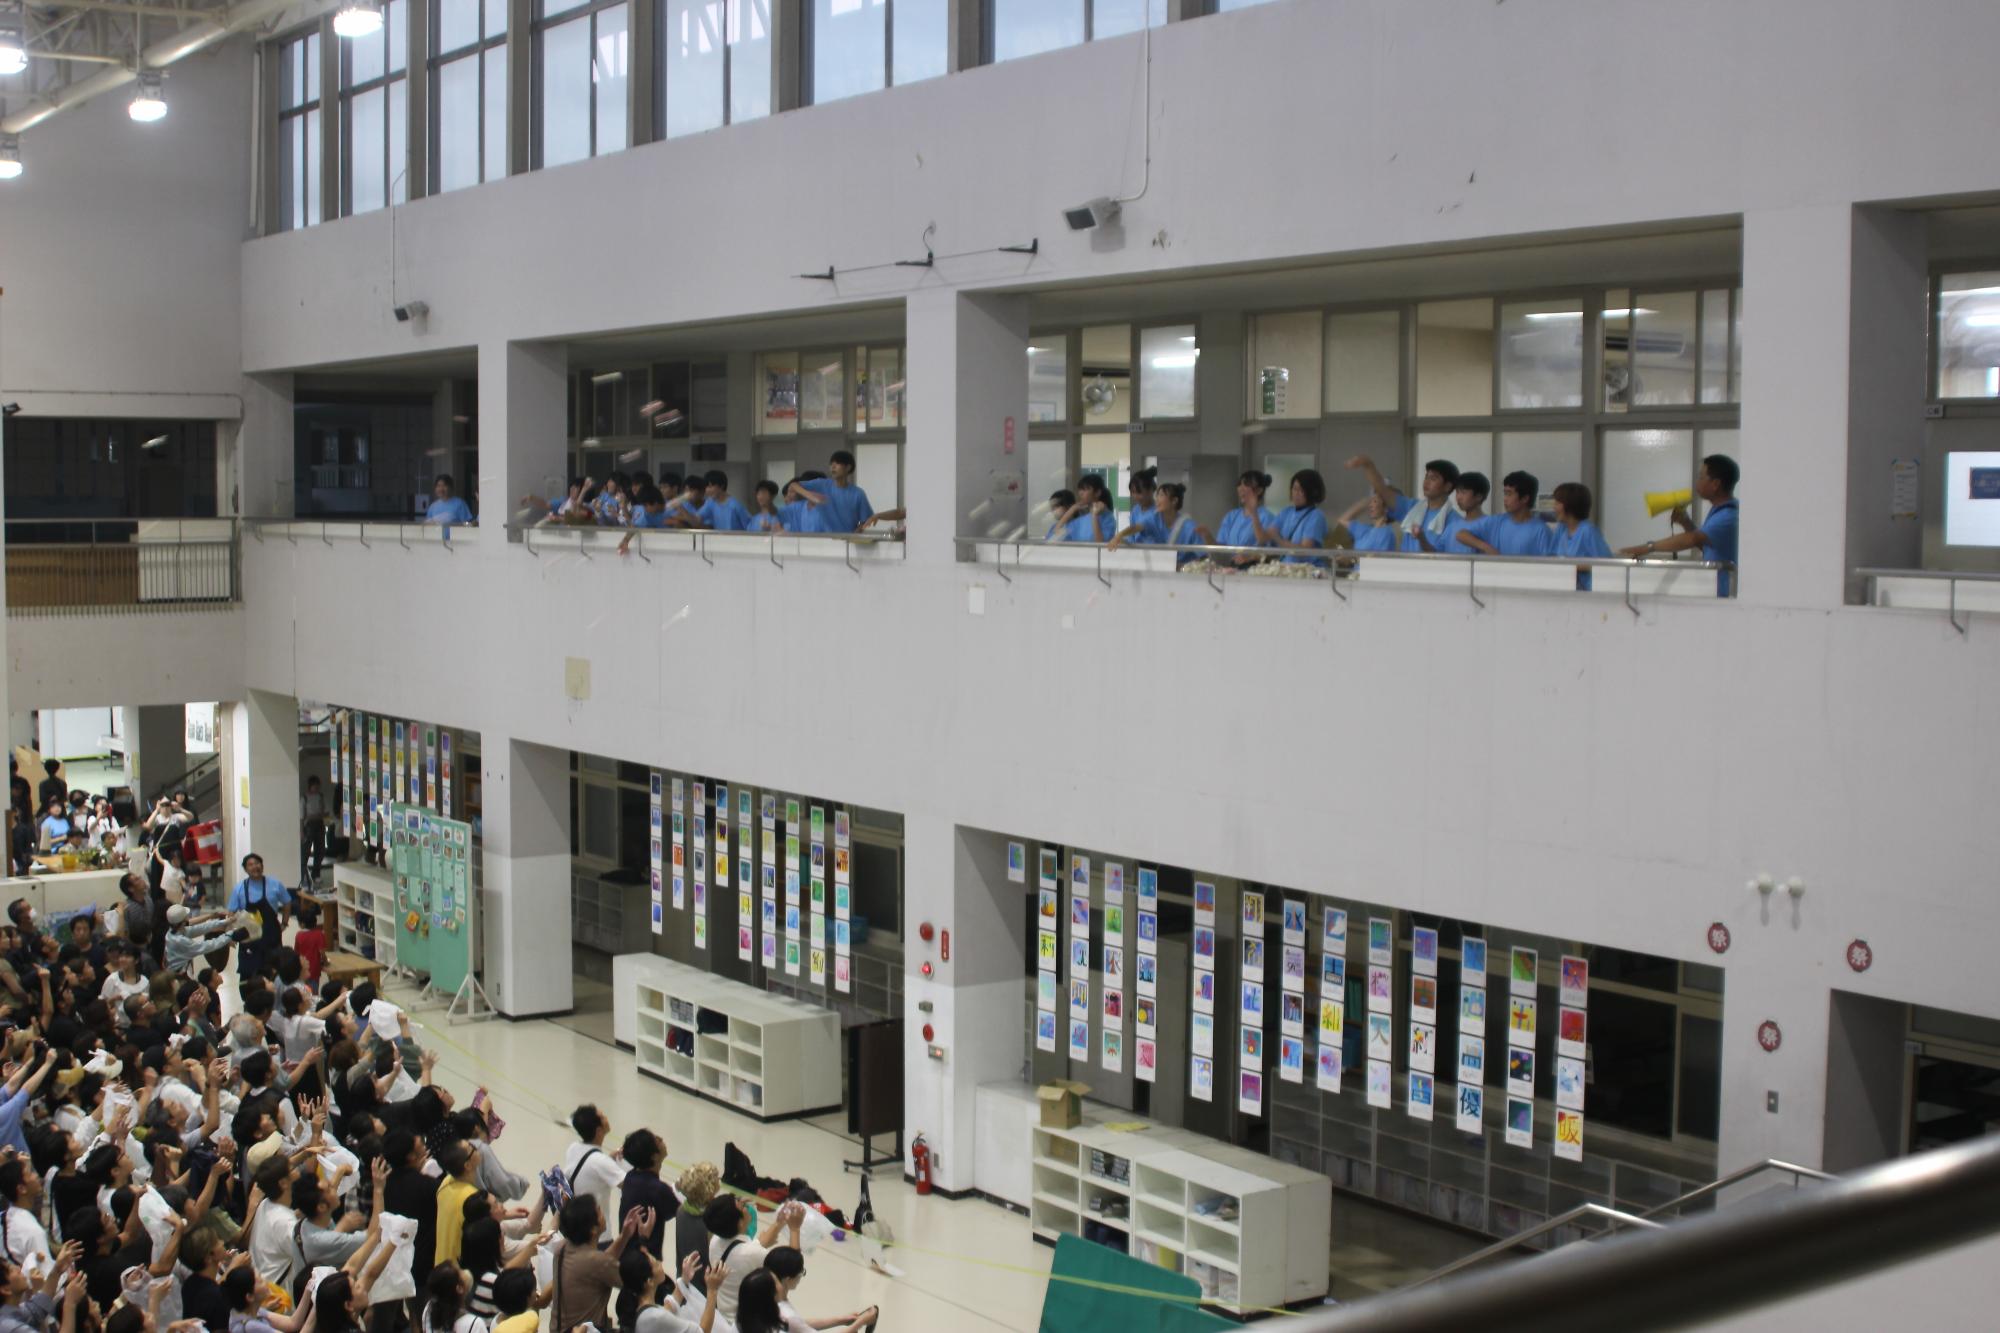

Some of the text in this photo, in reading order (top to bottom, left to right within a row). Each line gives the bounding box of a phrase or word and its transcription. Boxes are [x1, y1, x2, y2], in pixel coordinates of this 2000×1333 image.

[1712, 929, 1727, 948] 祭
[1851, 946, 1868, 966] 祭
[1762, 1028, 1778, 1046] 祭
